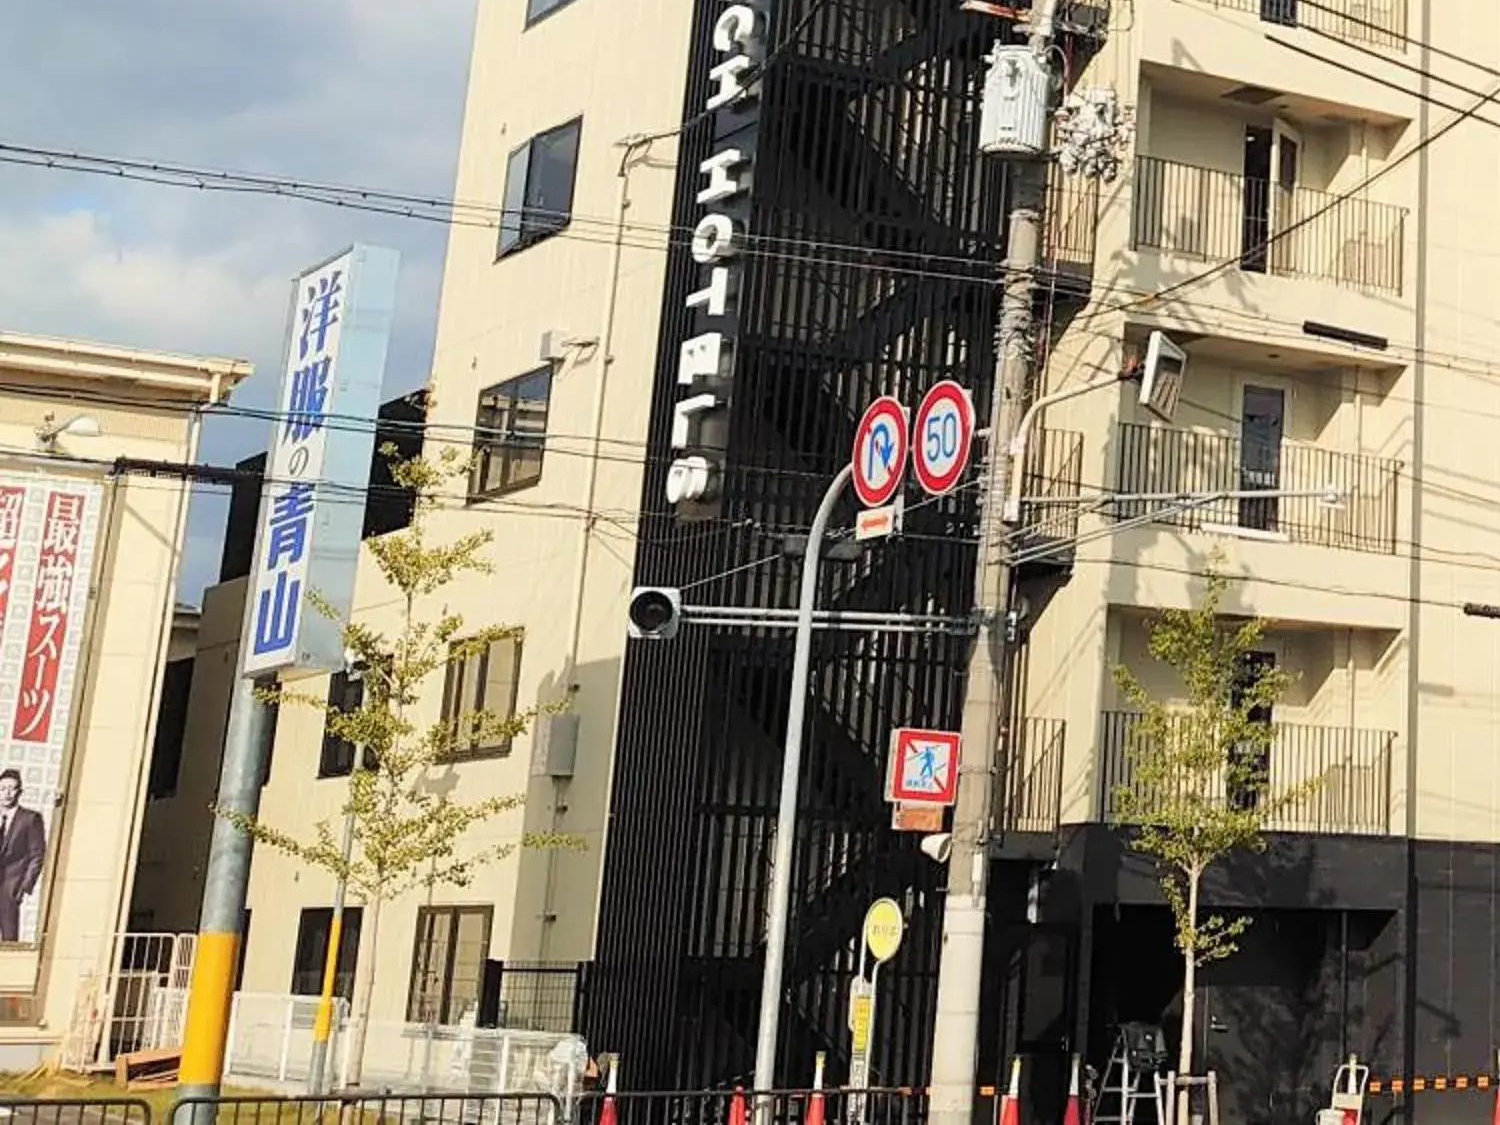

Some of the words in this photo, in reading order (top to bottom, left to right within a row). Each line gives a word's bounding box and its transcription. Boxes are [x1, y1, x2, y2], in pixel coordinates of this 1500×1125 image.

[253, 270, 342, 656] 洋服の青山
[665, 147, 742, 505] HOTELS
[926, 412, 957, 463] 50
[17, 494, 80, 737] 最強スーツ
